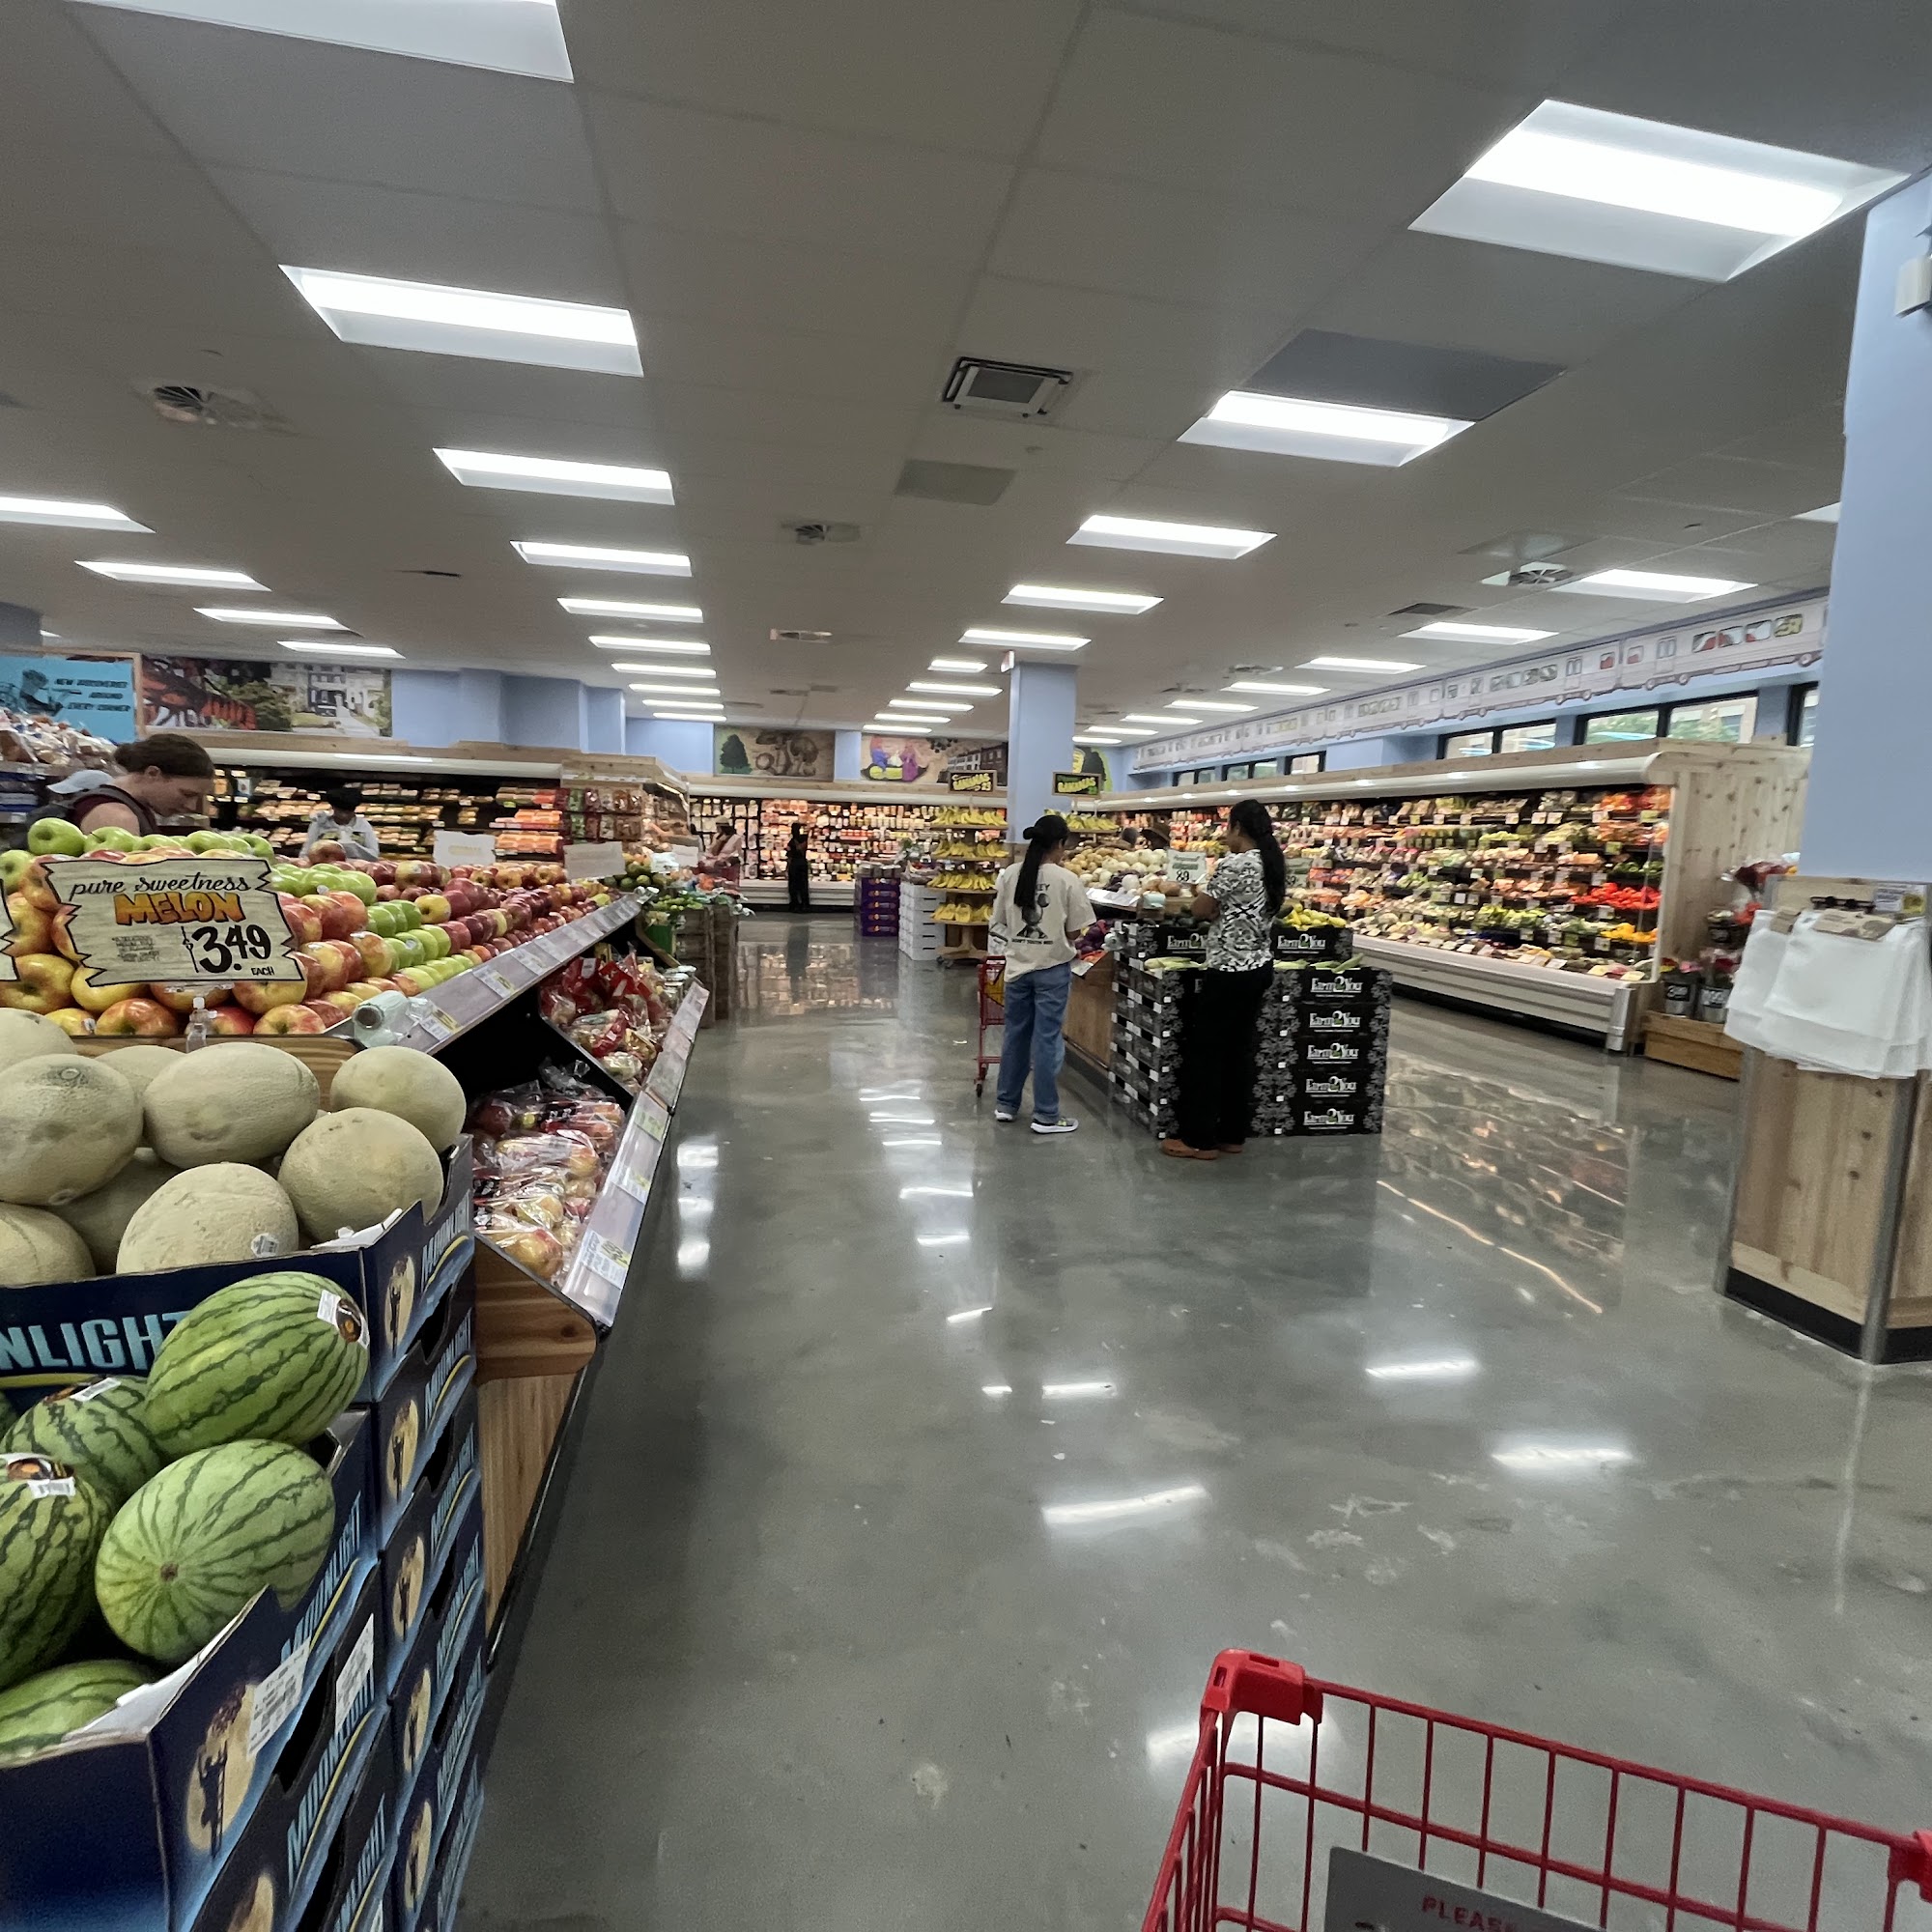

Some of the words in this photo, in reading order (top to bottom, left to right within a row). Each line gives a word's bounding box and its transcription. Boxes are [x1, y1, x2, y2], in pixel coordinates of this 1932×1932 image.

[69, 878, 127, 901] pure
[134, 871, 252, 892] sweetness
[113, 892, 246, 925] MELON
[250, 966, 275, 976] EACH
[0, 1310, 192, 1370] NLIGH
